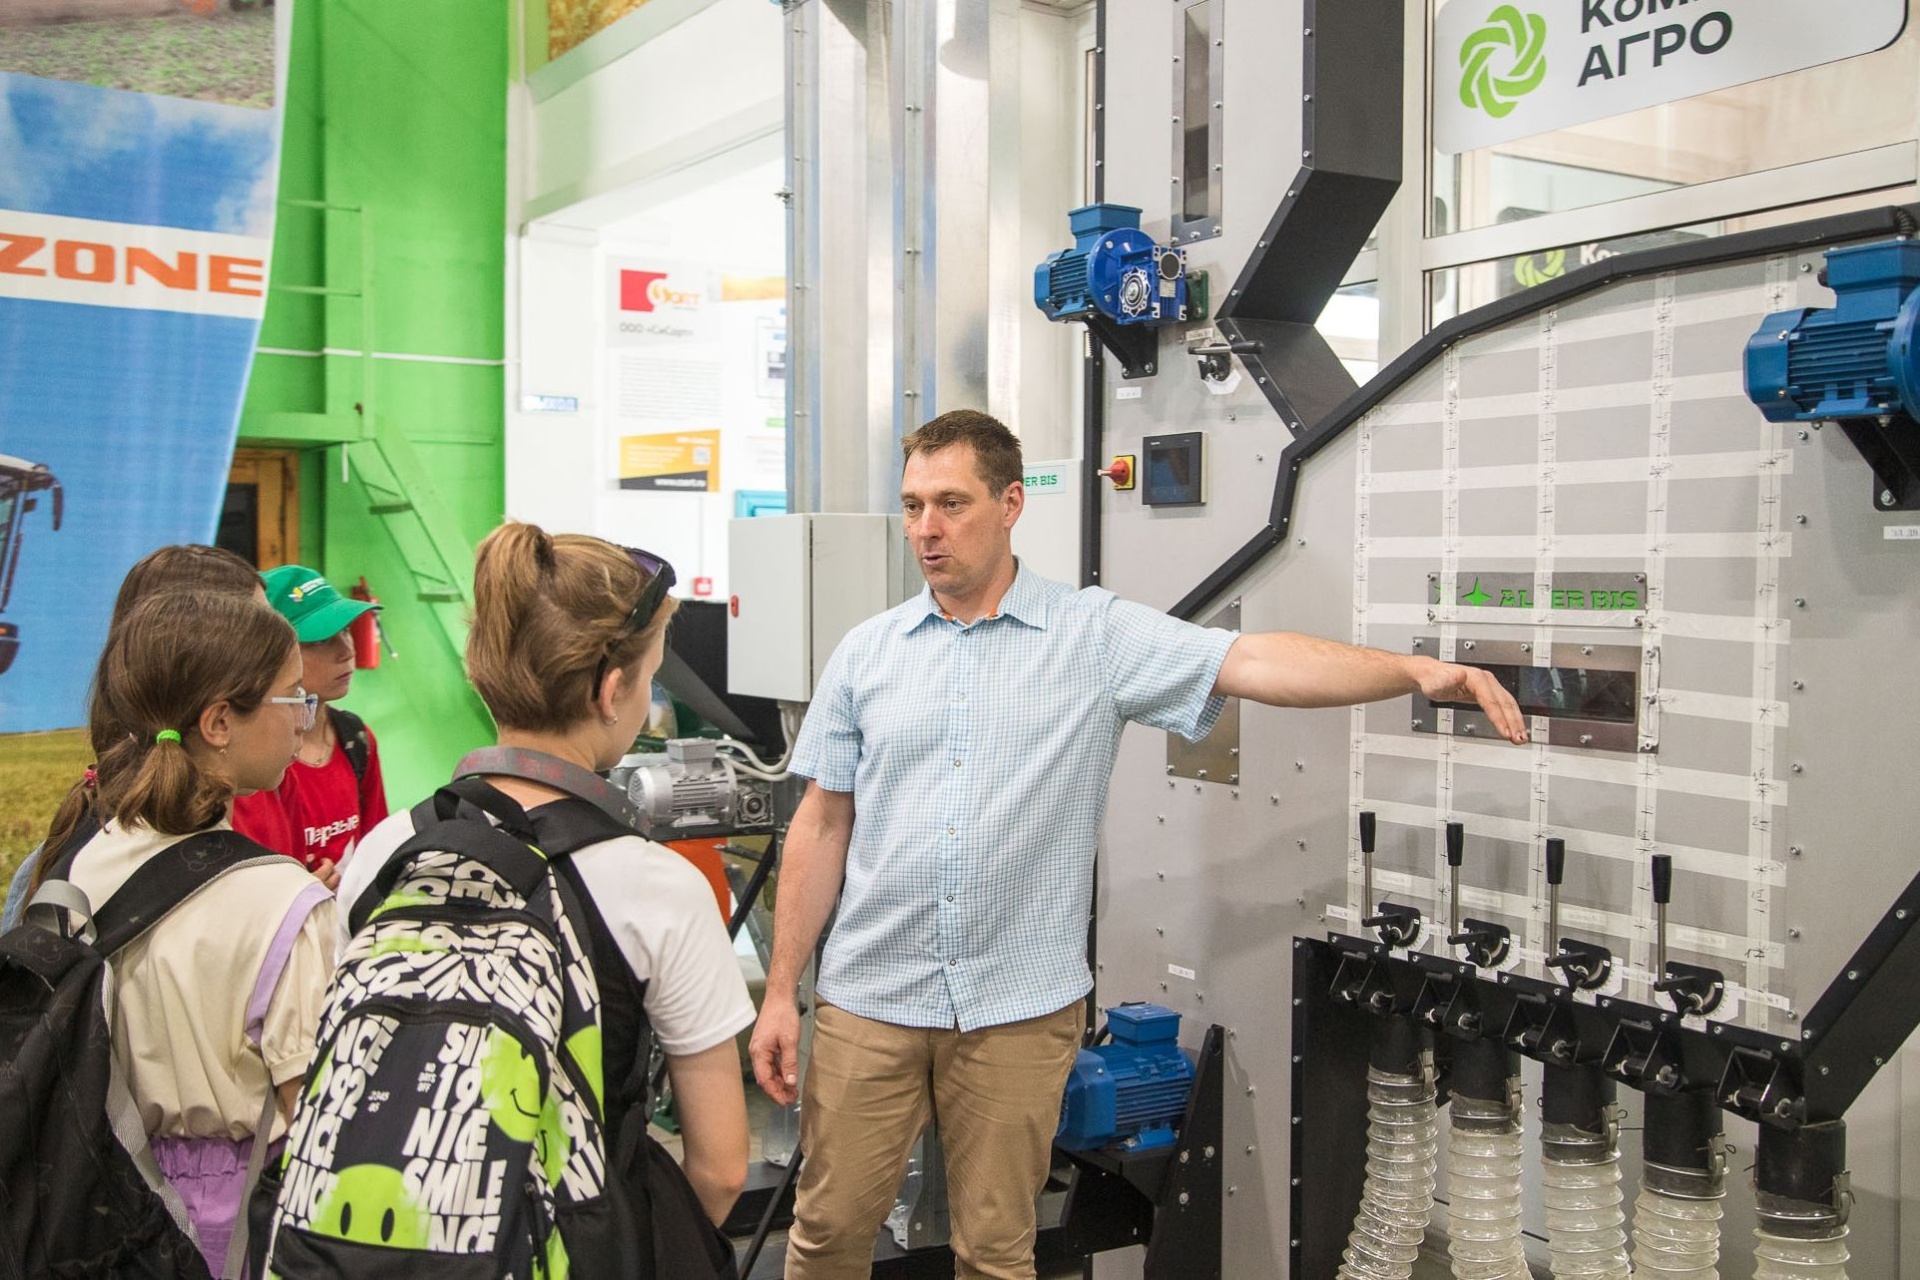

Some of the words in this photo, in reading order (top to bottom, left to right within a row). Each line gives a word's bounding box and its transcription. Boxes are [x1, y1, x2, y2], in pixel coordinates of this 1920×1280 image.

[1577, 11, 1733, 88] АГРО
[0, 232, 264, 297] ZONE
[1040, 474, 1057, 486] BIS
[1500, 589, 1584, 610] ALER
[1591, 590, 1638, 610] BIS
[304, 814, 359, 847] Первые
[328, 1013, 401, 1077] NCE
[401, 1107, 492, 1164] NICE
[401, 1157, 508, 1217] SMILE
